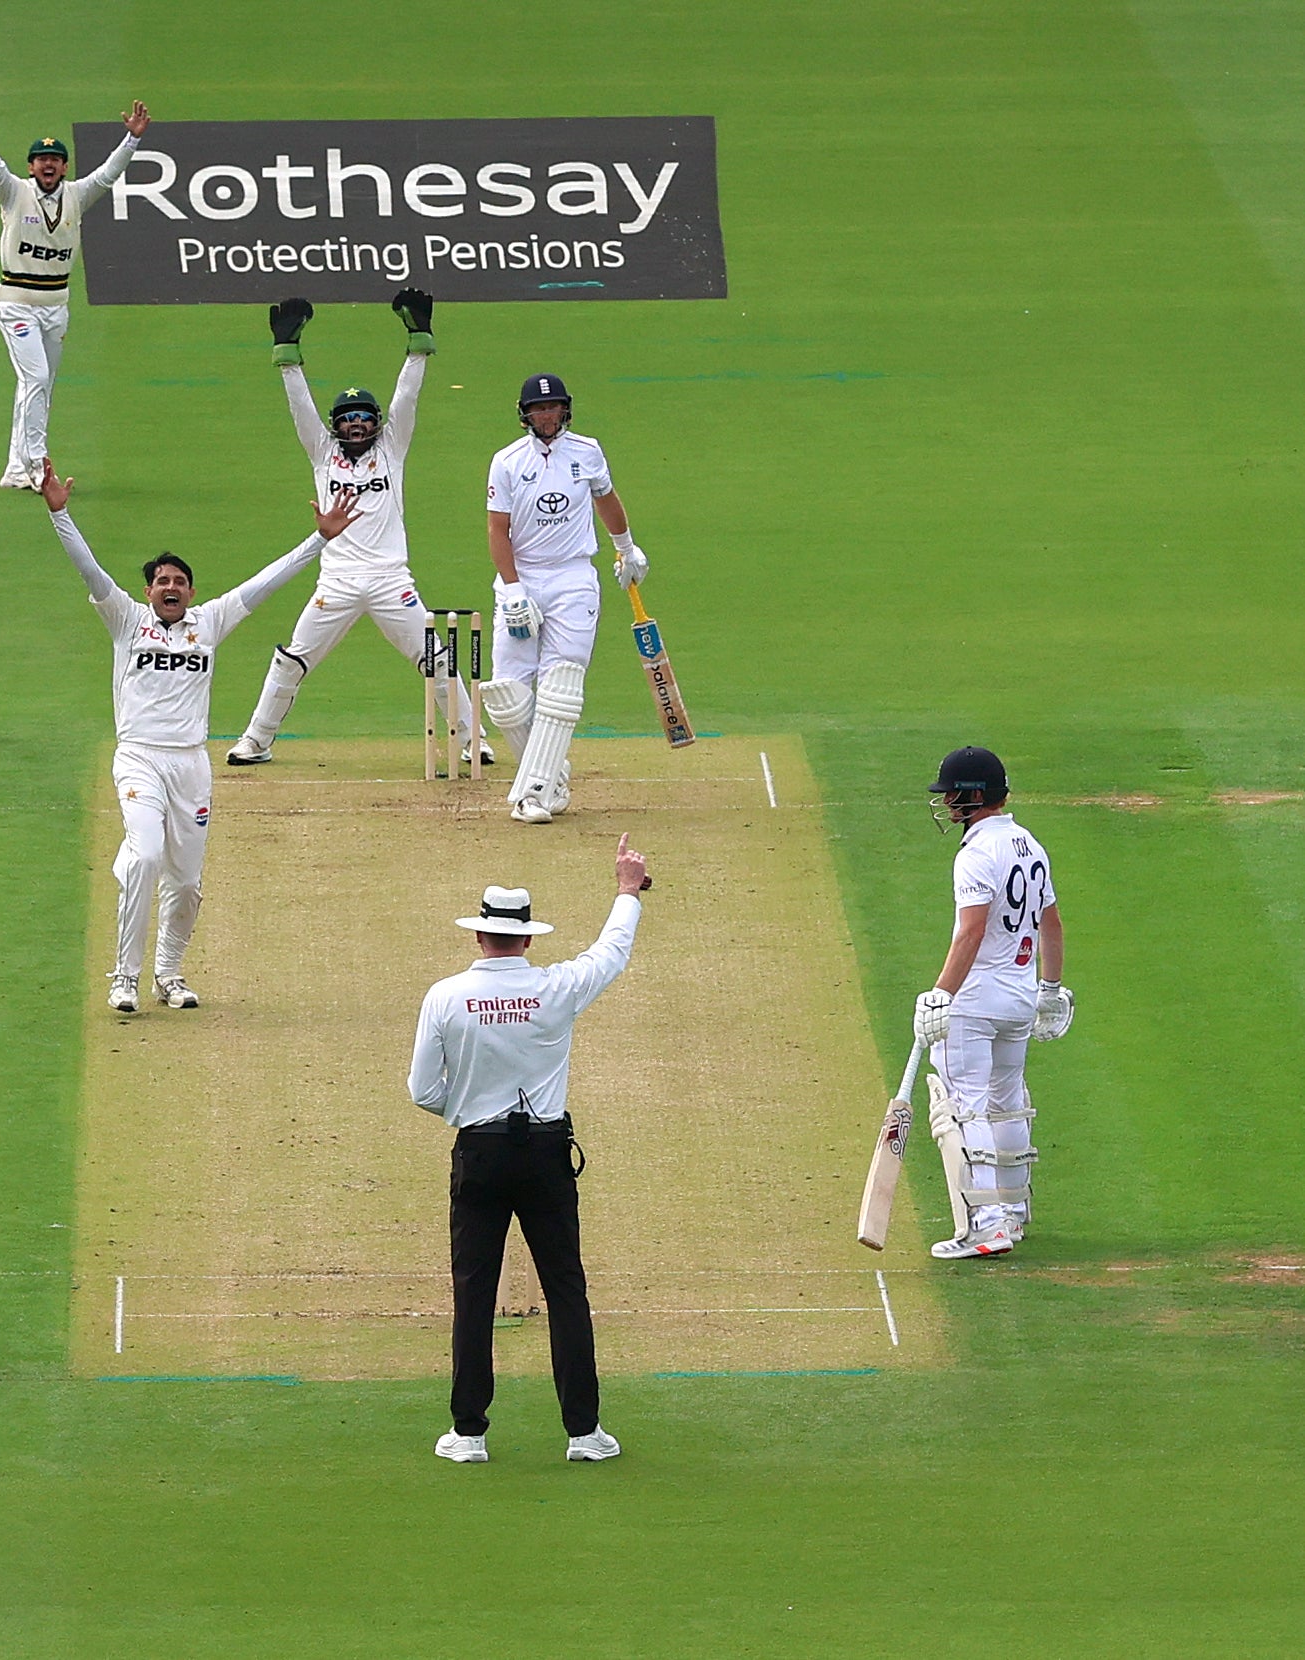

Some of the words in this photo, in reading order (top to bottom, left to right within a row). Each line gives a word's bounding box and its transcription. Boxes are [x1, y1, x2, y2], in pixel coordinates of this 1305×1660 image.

[113, 148, 679, 234] Rothesay
[24, 216, 40, 224] TCL
[18, 241, 73, 262] PEPSI
[178, 236, 409, 281] Protecting
[425, 233, 625, 271] Pensions
[329, 475, 390, 497] PEPSI
[536, 515, 570, 527] TOYOTA
[639, 625, 656, 656] new
[136, 652, 209, 673] PEPSI
[1002, 860, 1046, 933] 93
[465, 996, 541, 1013] Emirates
[479, 1013, 494, 1026] FLY
[497, 1011, 531, 1024] BETTER
